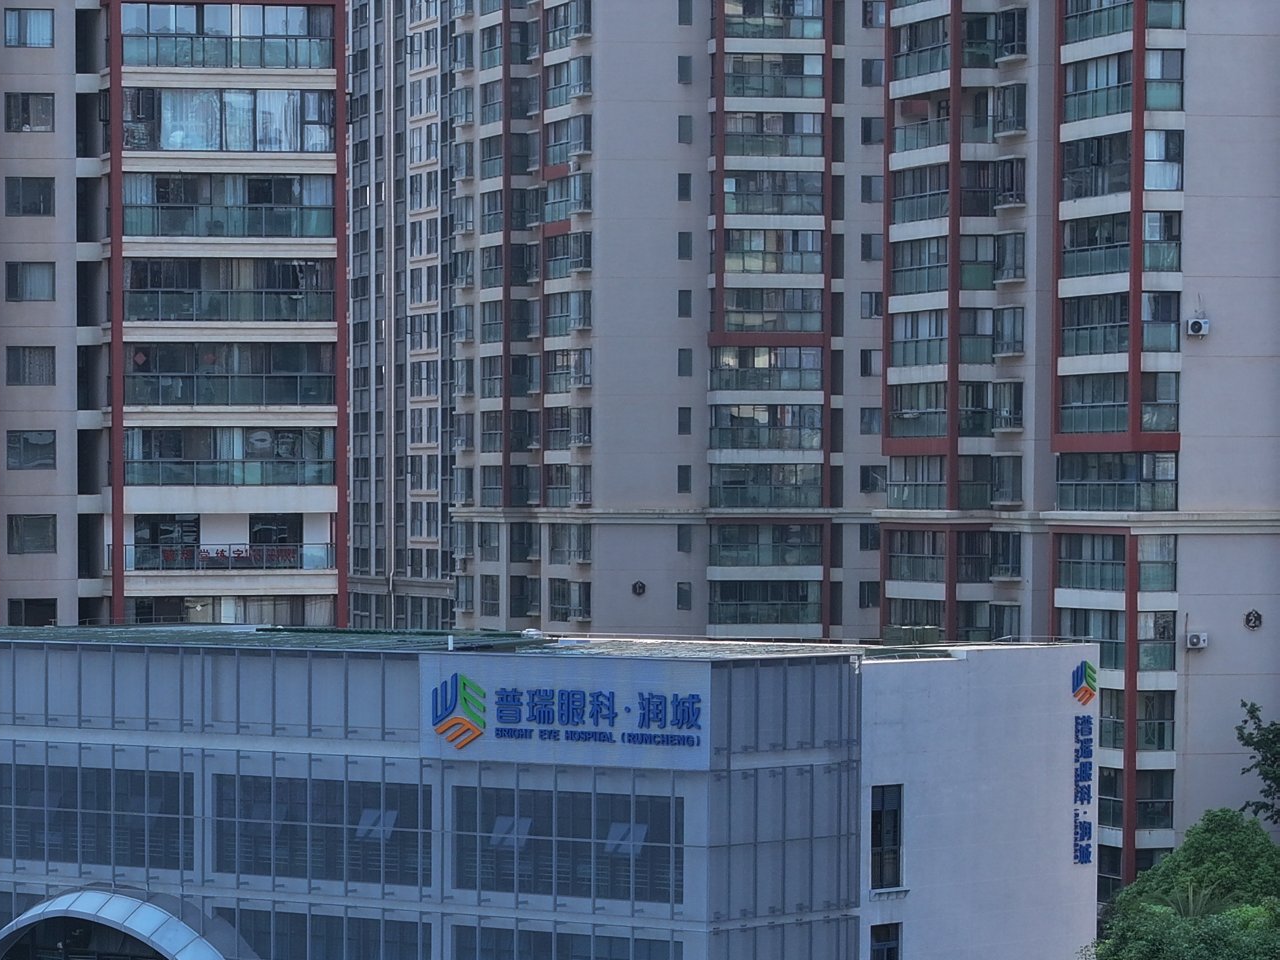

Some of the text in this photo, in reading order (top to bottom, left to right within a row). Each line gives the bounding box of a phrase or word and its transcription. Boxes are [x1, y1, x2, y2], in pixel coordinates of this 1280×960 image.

[495, 688, 701, 730] 普瑞眼科·润城
[495, 727, 534, 739] BRIGHT
[539, 729, 560, 741] EYE
[565, 730, 616, 743] HOSPITAL
